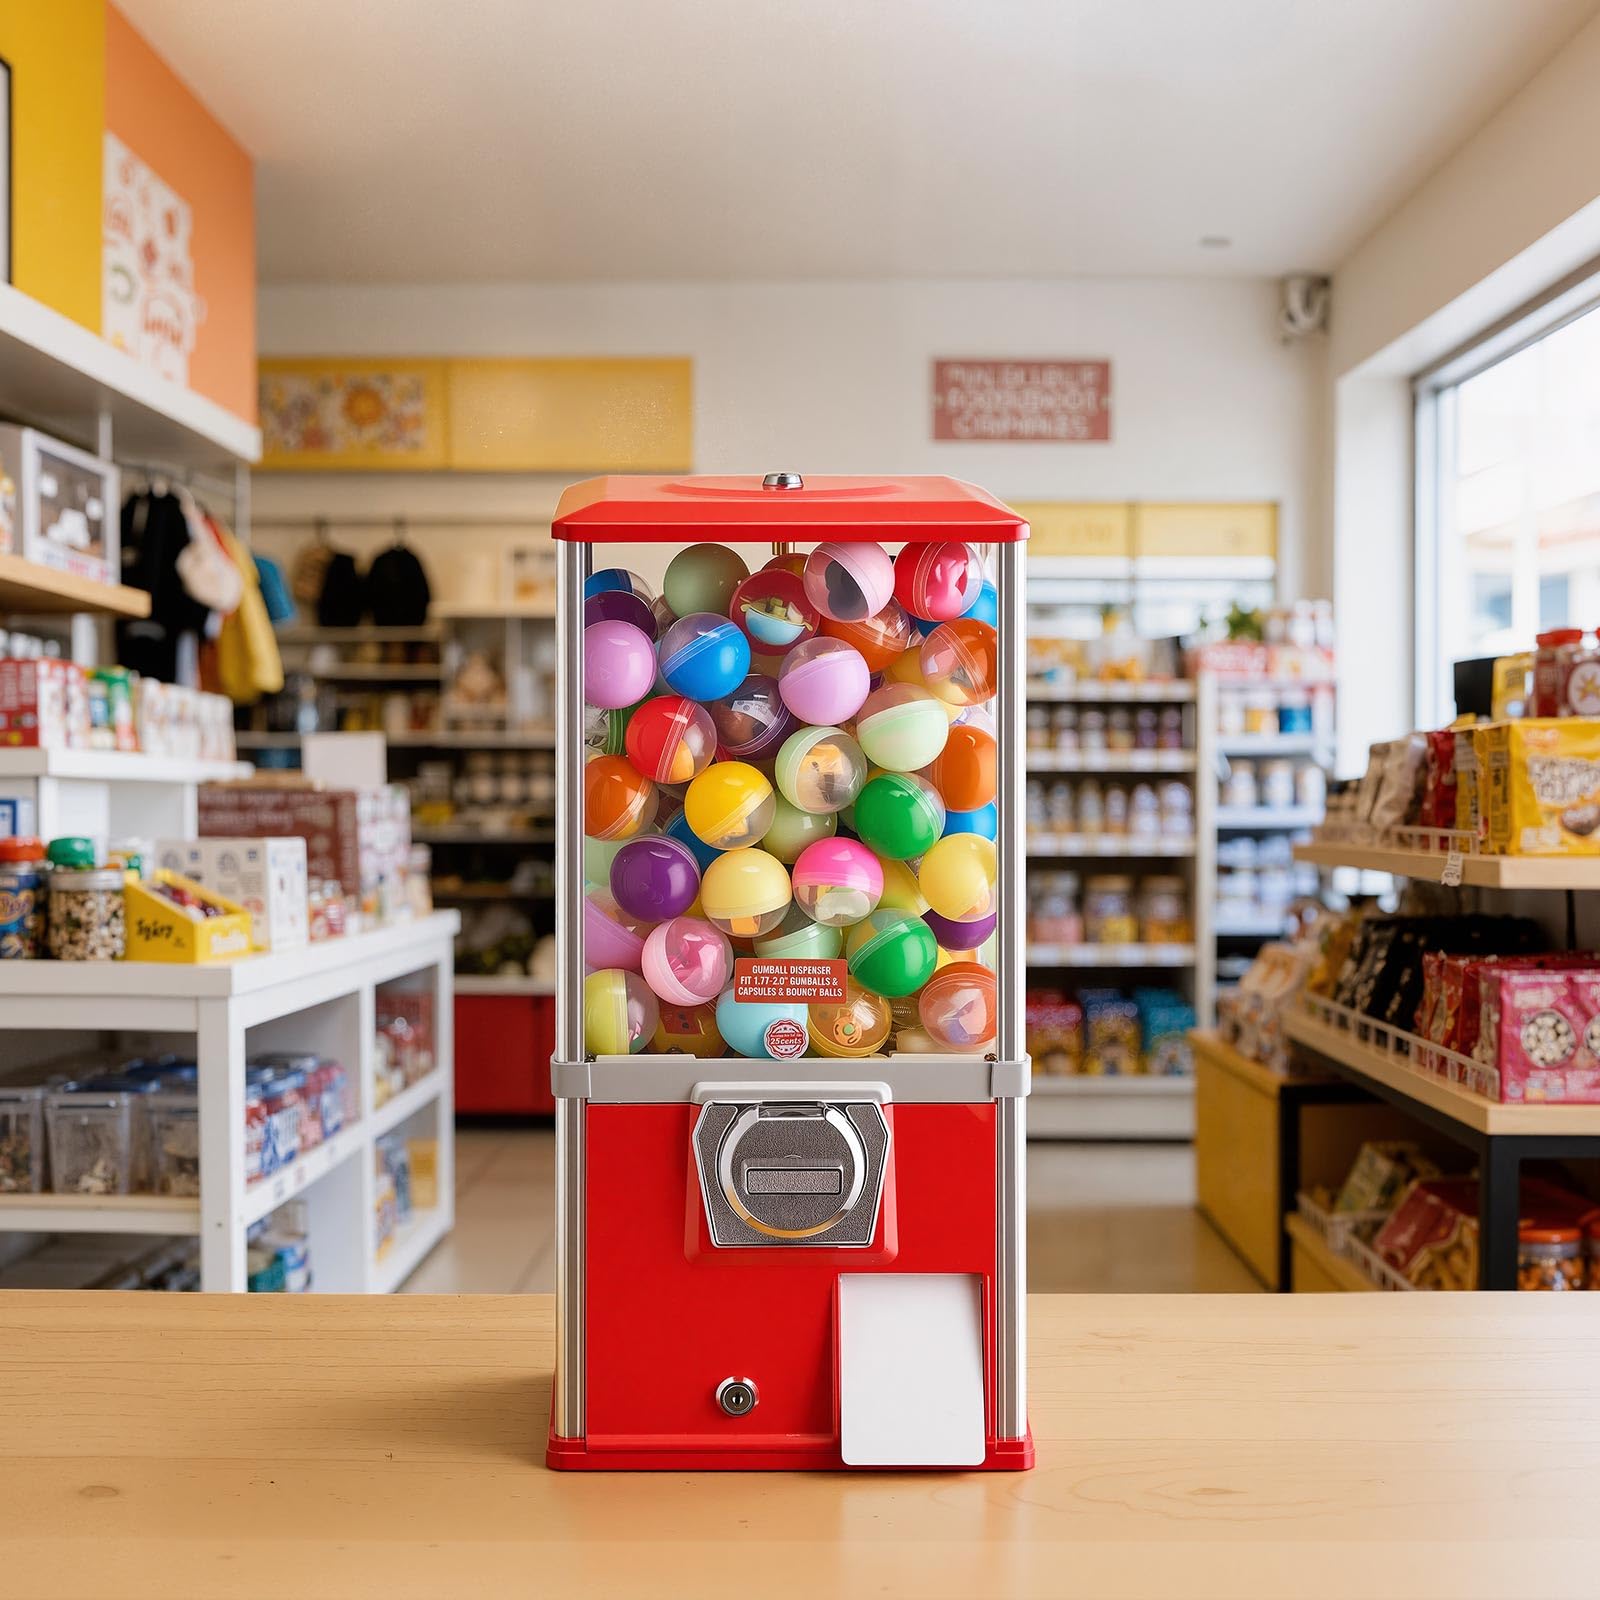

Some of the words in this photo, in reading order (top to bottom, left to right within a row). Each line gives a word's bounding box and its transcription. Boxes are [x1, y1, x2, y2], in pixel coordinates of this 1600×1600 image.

[752, 965, 788, 974] GUMBALL
[790, 966, 831, 974] DISPENSER
[740, 976, 751, 985] FIT
[790, 977, 830, 985] GUMBALLS
[832, 977, 838, 985] &
[738, 987, 776, 996] CAPSULES
[778, 987, 784, 996] &
[786, 987, 817, 996] BOUNCY
[819, 988, 843, 997] BALLS
